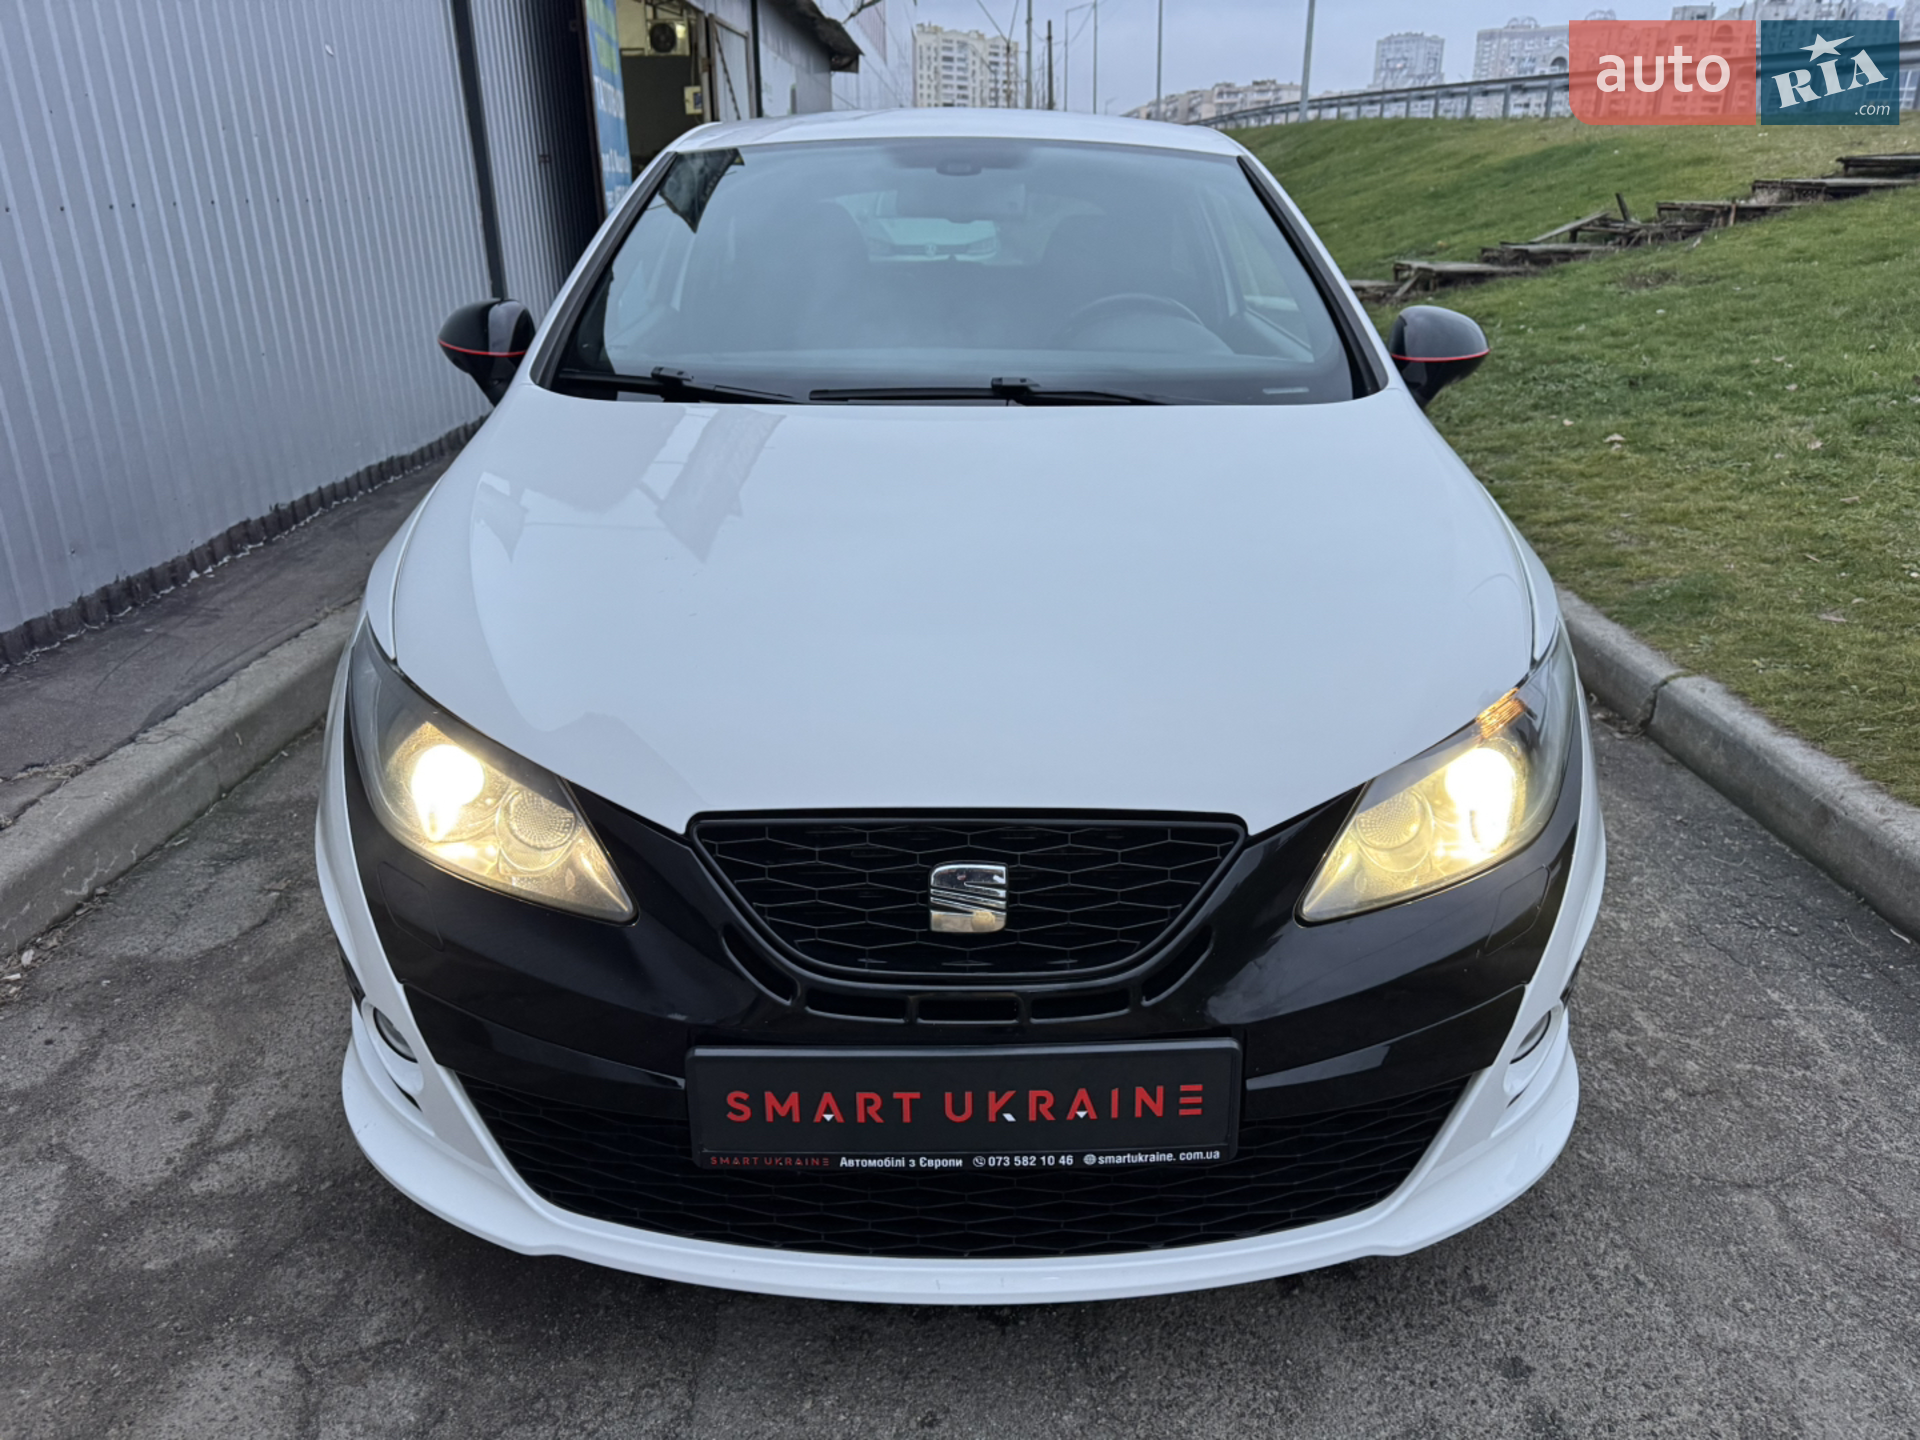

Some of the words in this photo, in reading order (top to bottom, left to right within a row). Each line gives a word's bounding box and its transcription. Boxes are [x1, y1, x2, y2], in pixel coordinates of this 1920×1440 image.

[726, 1089, 921, 1124] SMART
[944, 1083, 1204, 1124] UKRAINE
[710, 1156, 759, 1166] SMART
[764, 1156, 830, 1166] UKRAINE
[839, 1156, 905, 1168] Автомобілі
[909, 1158, 916, 1167] з
[919, 1156, 963, 1169] Європи
[988, 1156, 1010, 1167] 073
[1014, 1155, 1037, 1166] 582
[1040, 1155, 1055, 1166] 10
[1058, 1154, 1074, 1166] 46
